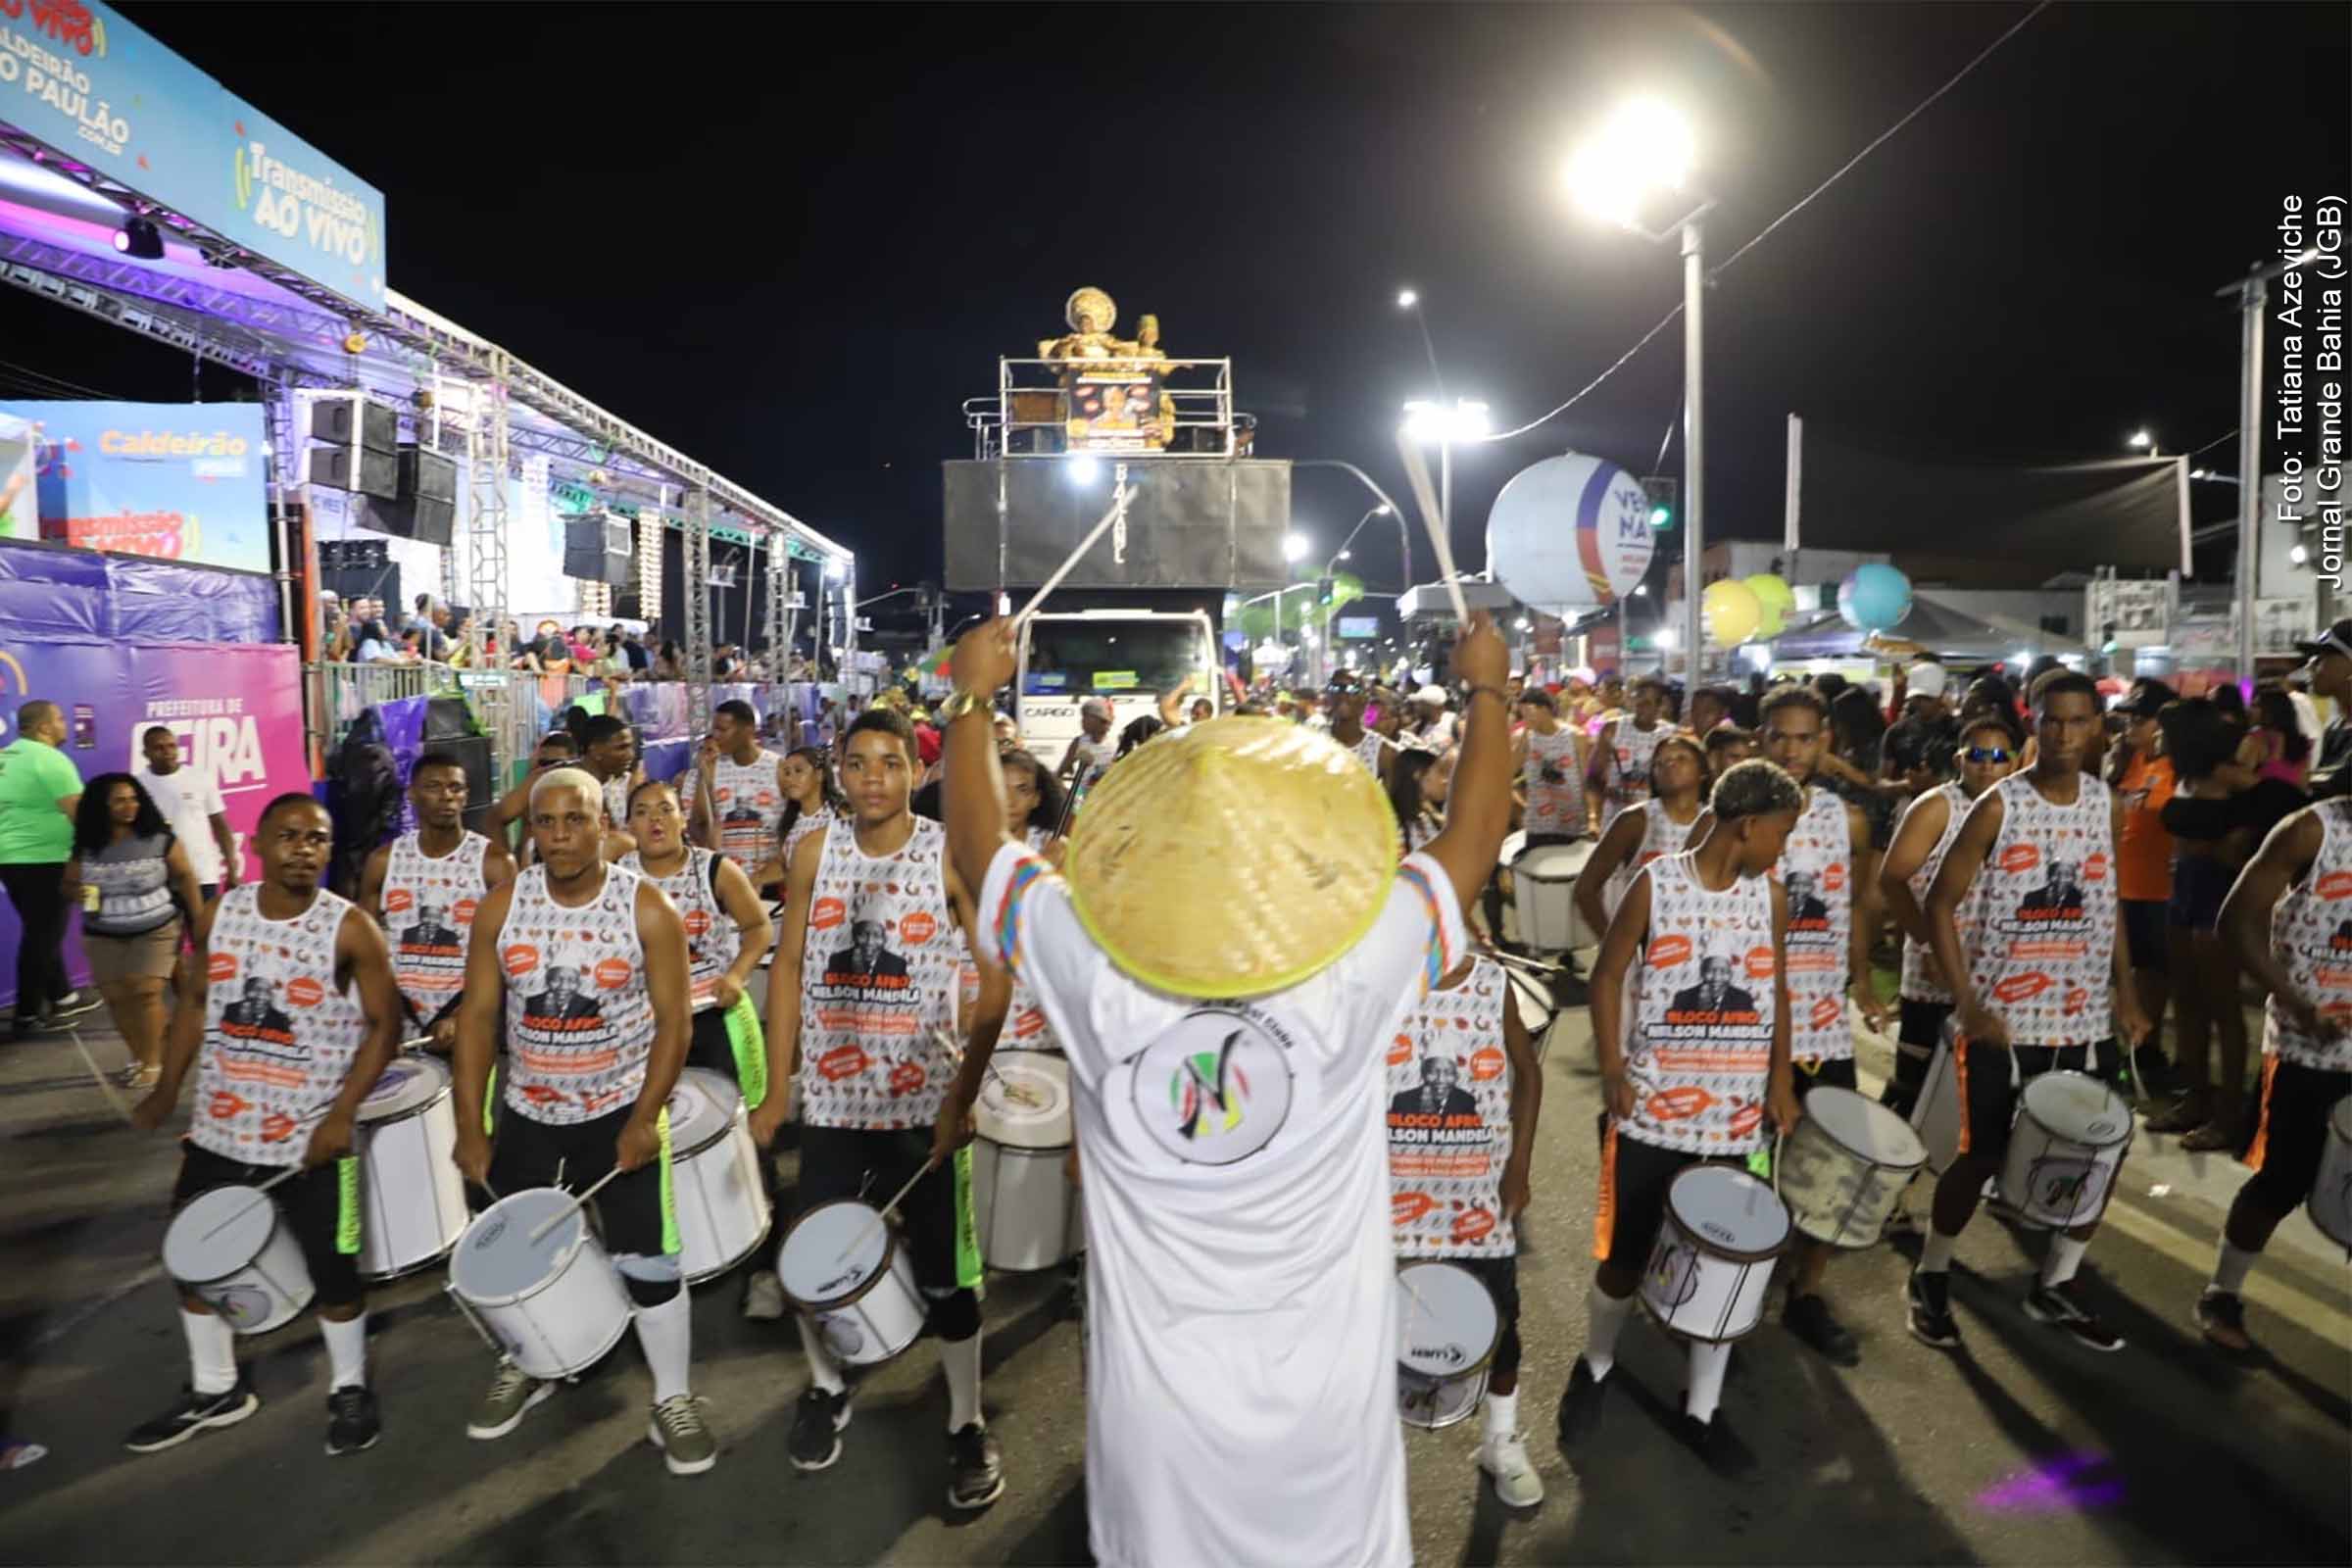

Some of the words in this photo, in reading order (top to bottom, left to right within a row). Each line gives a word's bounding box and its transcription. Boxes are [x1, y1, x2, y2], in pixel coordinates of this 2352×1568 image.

[25, 67, 129, 144] PAULÃO
[250, 140, 367, 222] Transmissão
[255, 188, 299, 238] AO
[306, 208, 367, 266] VIVO
[100, 429, 247, 456] Caldeirão
[225, 697, 244, 714] DE
